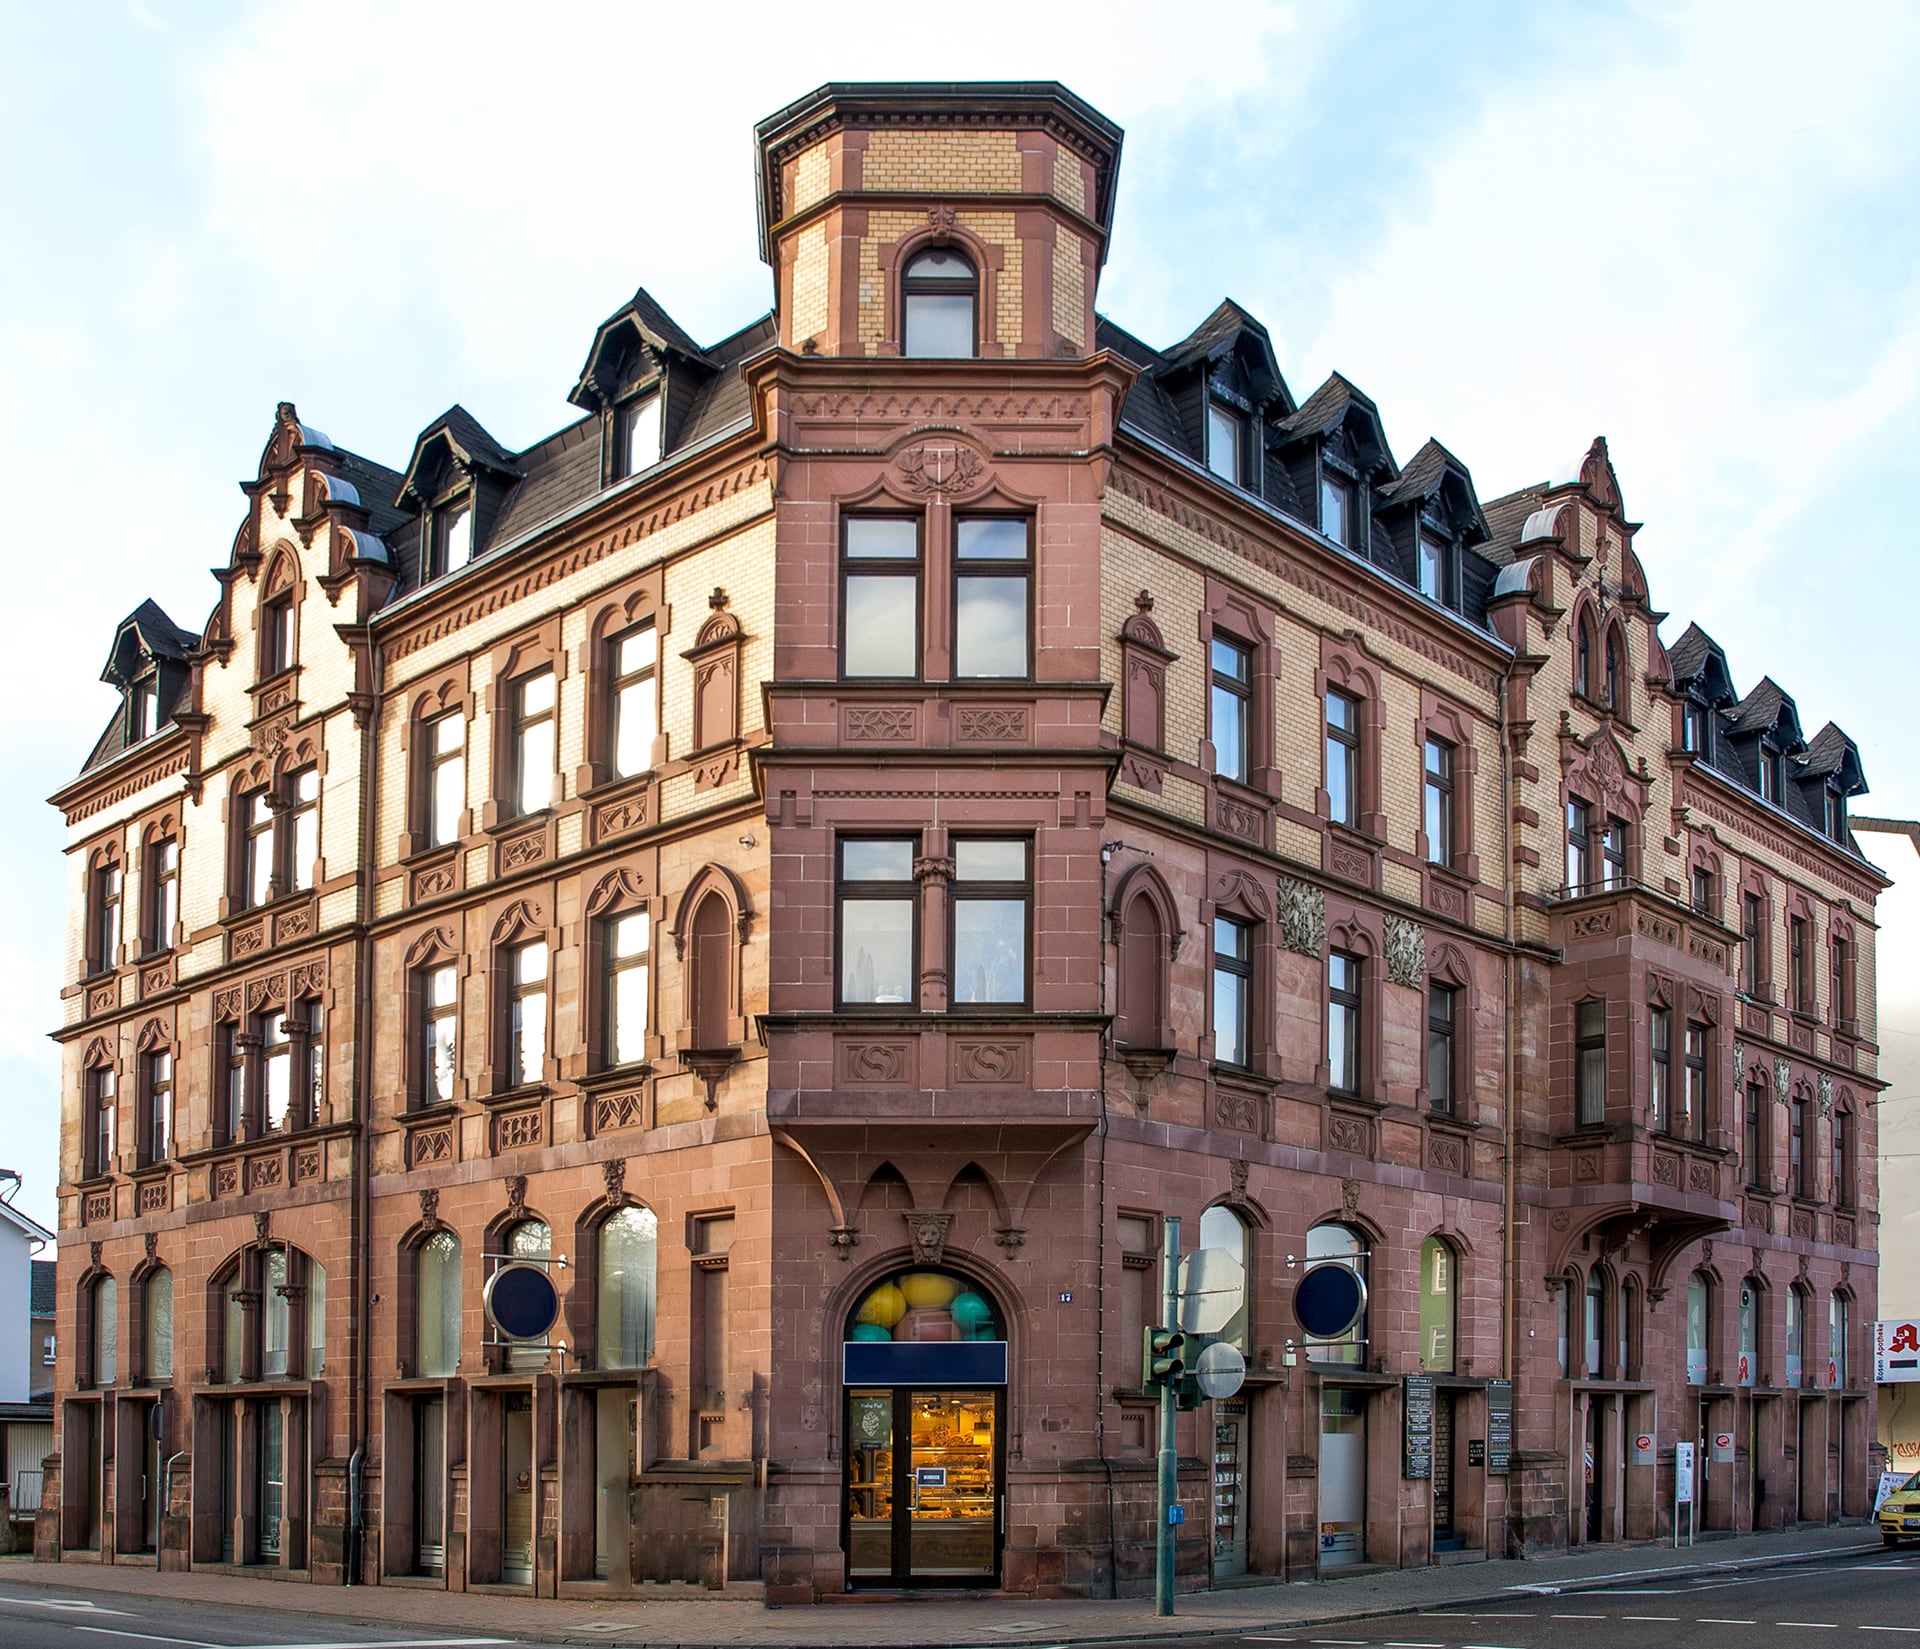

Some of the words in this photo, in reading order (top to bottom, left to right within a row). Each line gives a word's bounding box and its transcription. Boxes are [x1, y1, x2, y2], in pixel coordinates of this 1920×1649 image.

[1061, 1293, 1071, 1302] 17
[1876, 1323, 1885, 1357] Apotheke
[1876, 1360, 1884, 1381] Rosen
